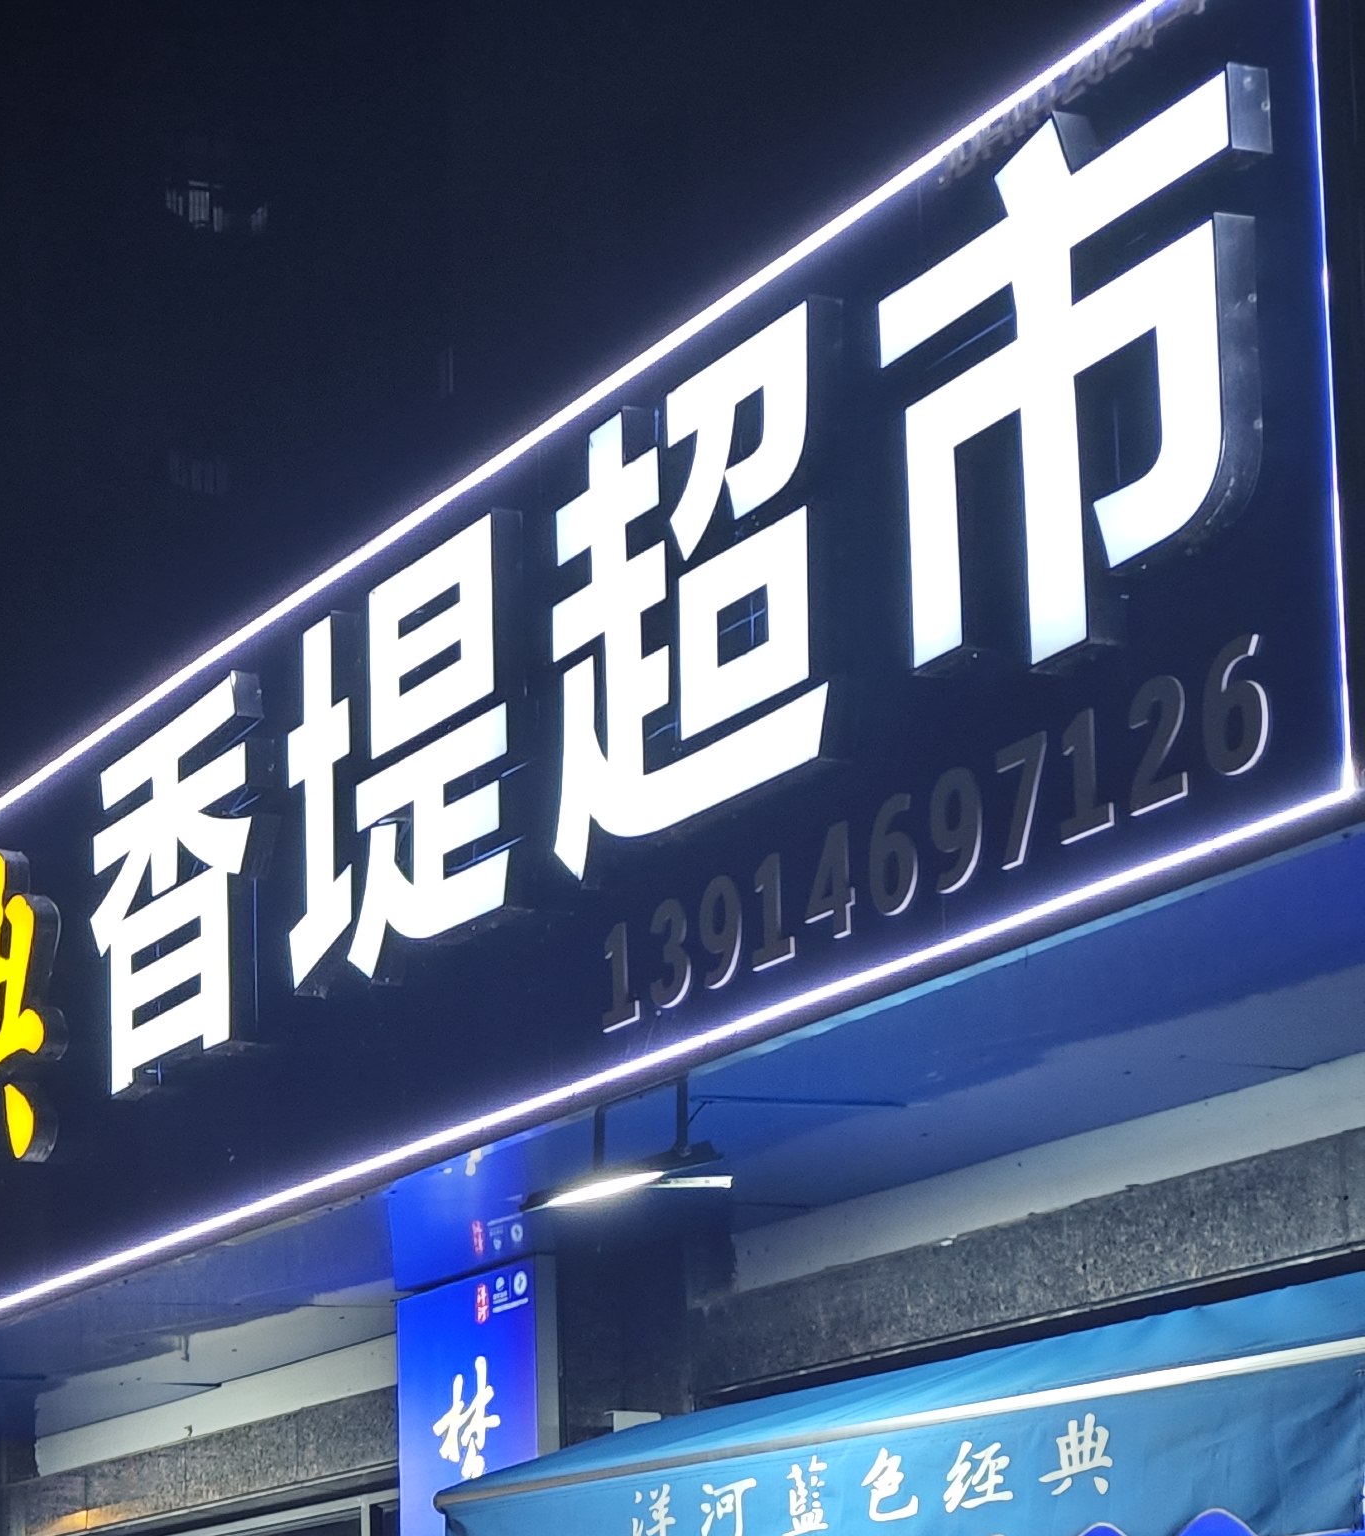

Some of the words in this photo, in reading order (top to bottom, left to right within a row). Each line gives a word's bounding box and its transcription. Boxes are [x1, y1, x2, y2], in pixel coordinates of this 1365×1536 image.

[89, 68, 1231, 1096] 香堤超市
[601, 632, 1272, 1034] 13914697126
